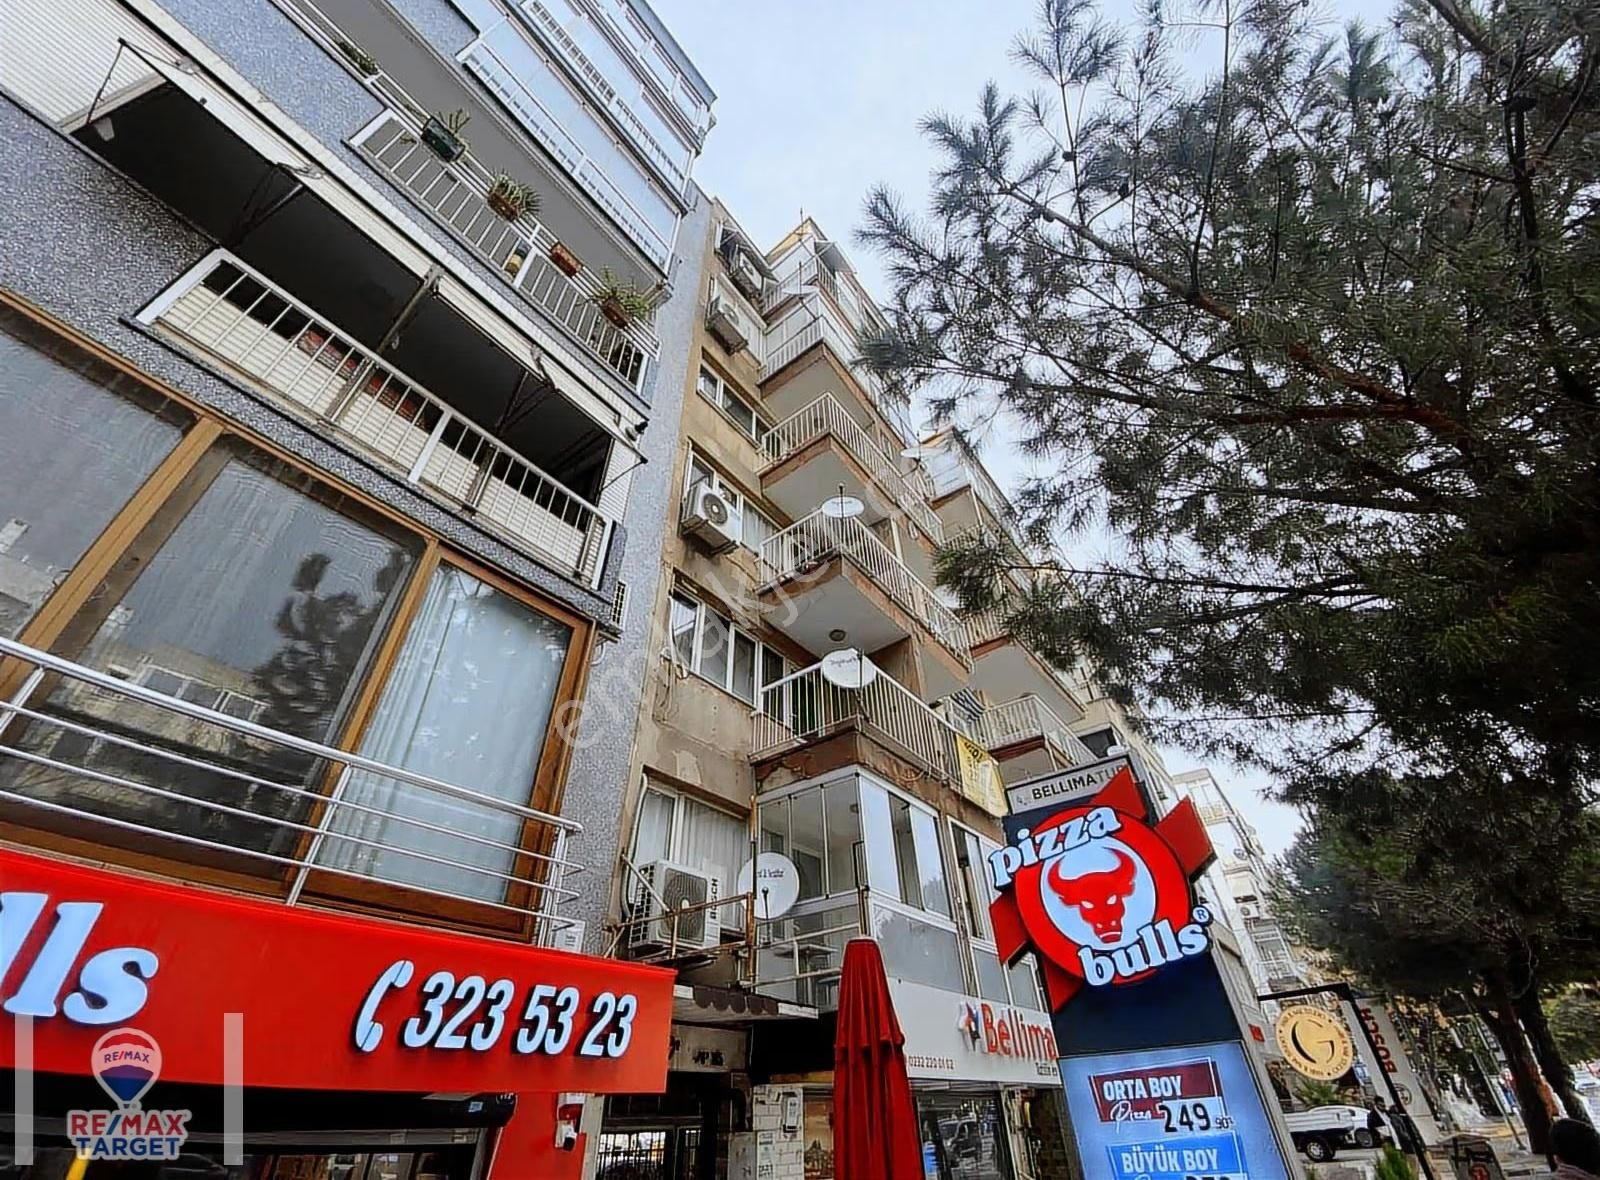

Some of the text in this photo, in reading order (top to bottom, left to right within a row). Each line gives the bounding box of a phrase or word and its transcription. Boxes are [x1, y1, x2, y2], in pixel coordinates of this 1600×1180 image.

[988, 806, 1121, 887] pizza
[402, 971, 638, 1058] 323 53 23
[1360, 1007, 1397, 1073] BOSCH
[1103, 1075, 1182, 1101] ORTA BOY
[1158, 1102, 1211, 1133] 249
[1121, 1145, 1218, 1174] BÜYÜK BOY
